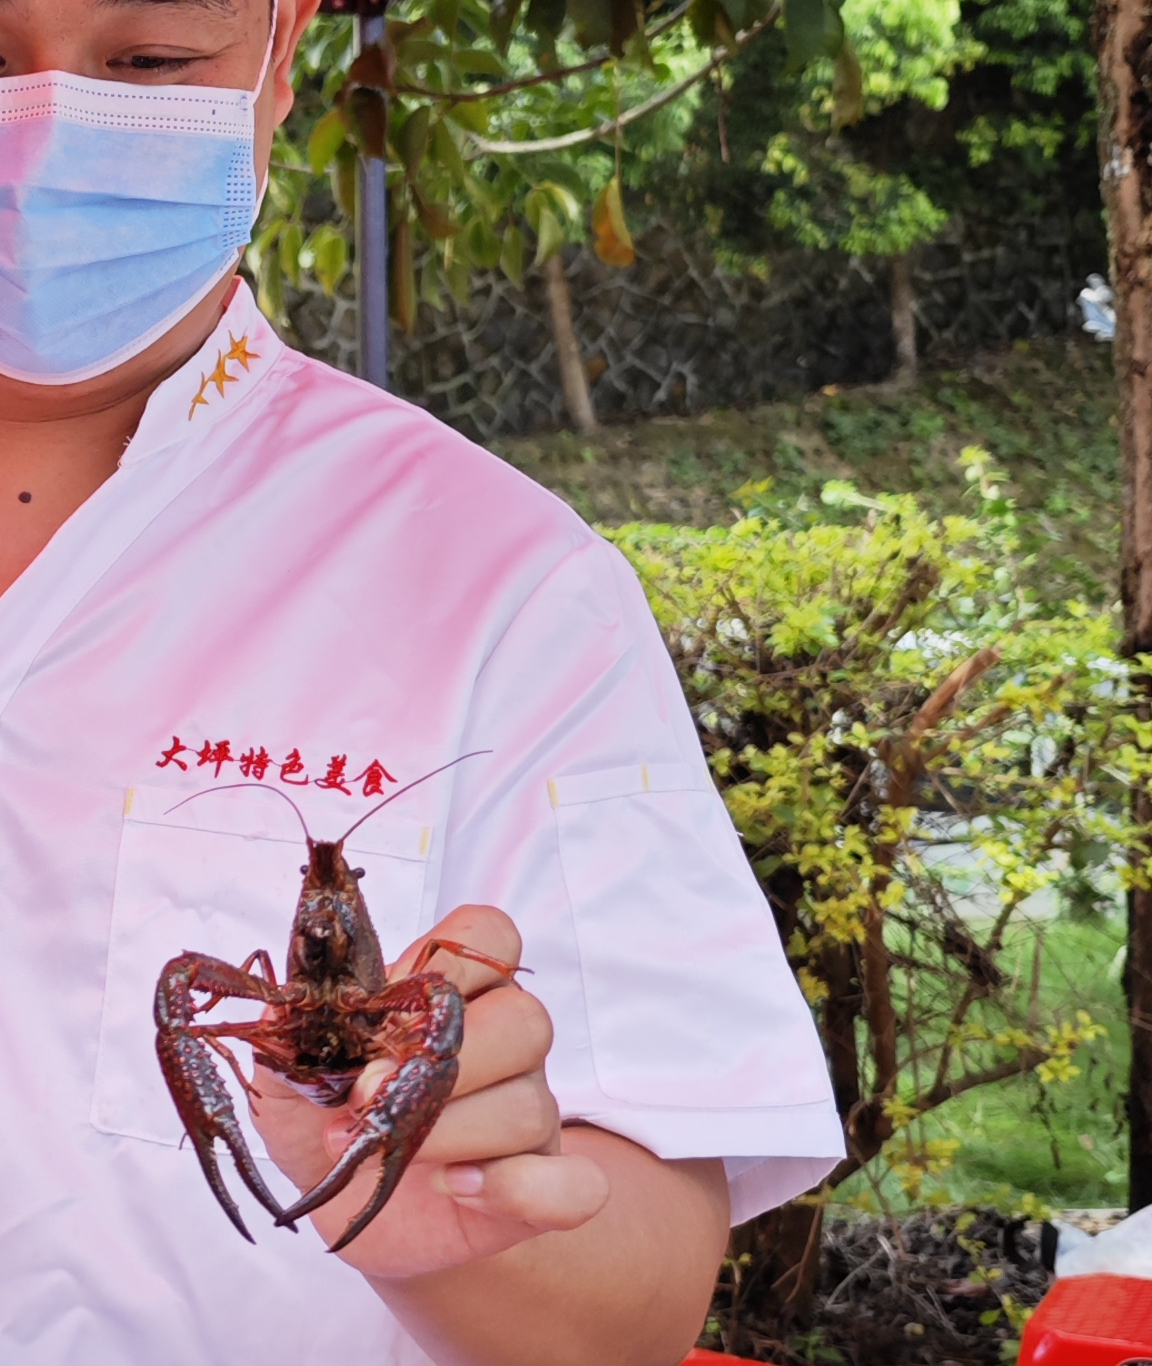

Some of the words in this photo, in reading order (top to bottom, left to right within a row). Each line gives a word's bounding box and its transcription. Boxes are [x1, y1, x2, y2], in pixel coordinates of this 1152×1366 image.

[155, 735, 399, 797] 大坪特色美食
